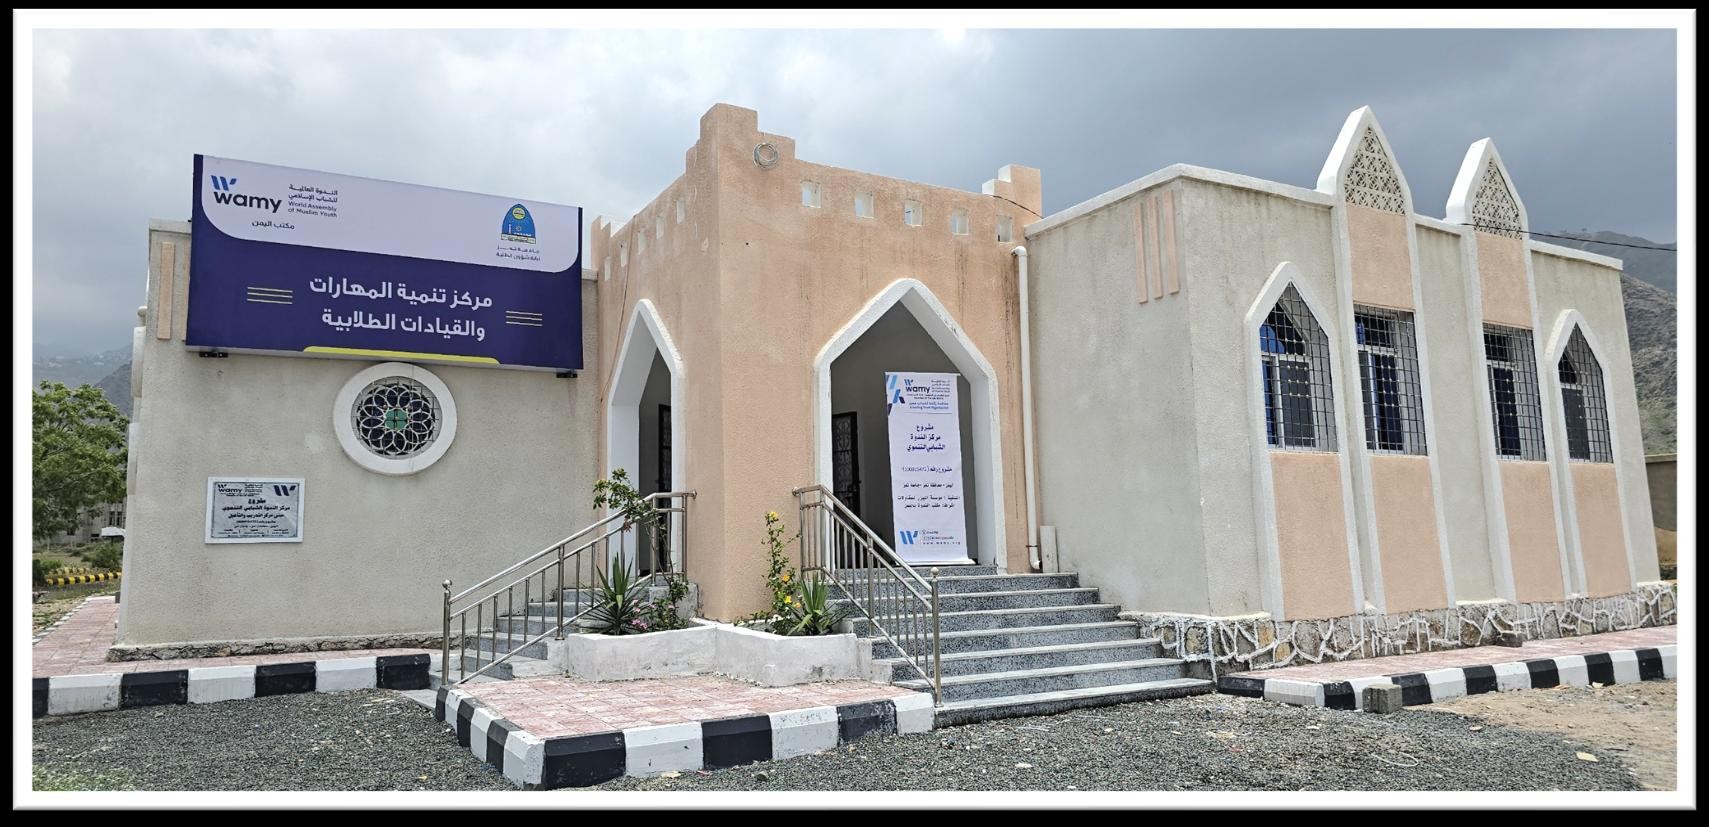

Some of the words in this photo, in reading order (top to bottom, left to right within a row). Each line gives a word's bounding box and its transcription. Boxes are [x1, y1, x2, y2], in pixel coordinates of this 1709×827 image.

[213, 191, 282, 213] wamy
[296, 208, 318, 216] Muslim
[308, 203, 337, 212] Assembly
[251, 220, 272, 228] اليمن
[273, 221, 295, 230] مكتب
[309, 277, 392, 300] المهارات
[397, 284, 447, 305] تنمية
[450, 290, 493, 310] مركز
[322, 308, 396, 332] الطلابية
[400, 316, 487, 342] والقيادات
[905, 386, 931, 394] wamy
[916, 423, 934, 432] مشروع
[907, 444, 926, 452] التنموي
[926, 444, 945, 452] الشبابي
